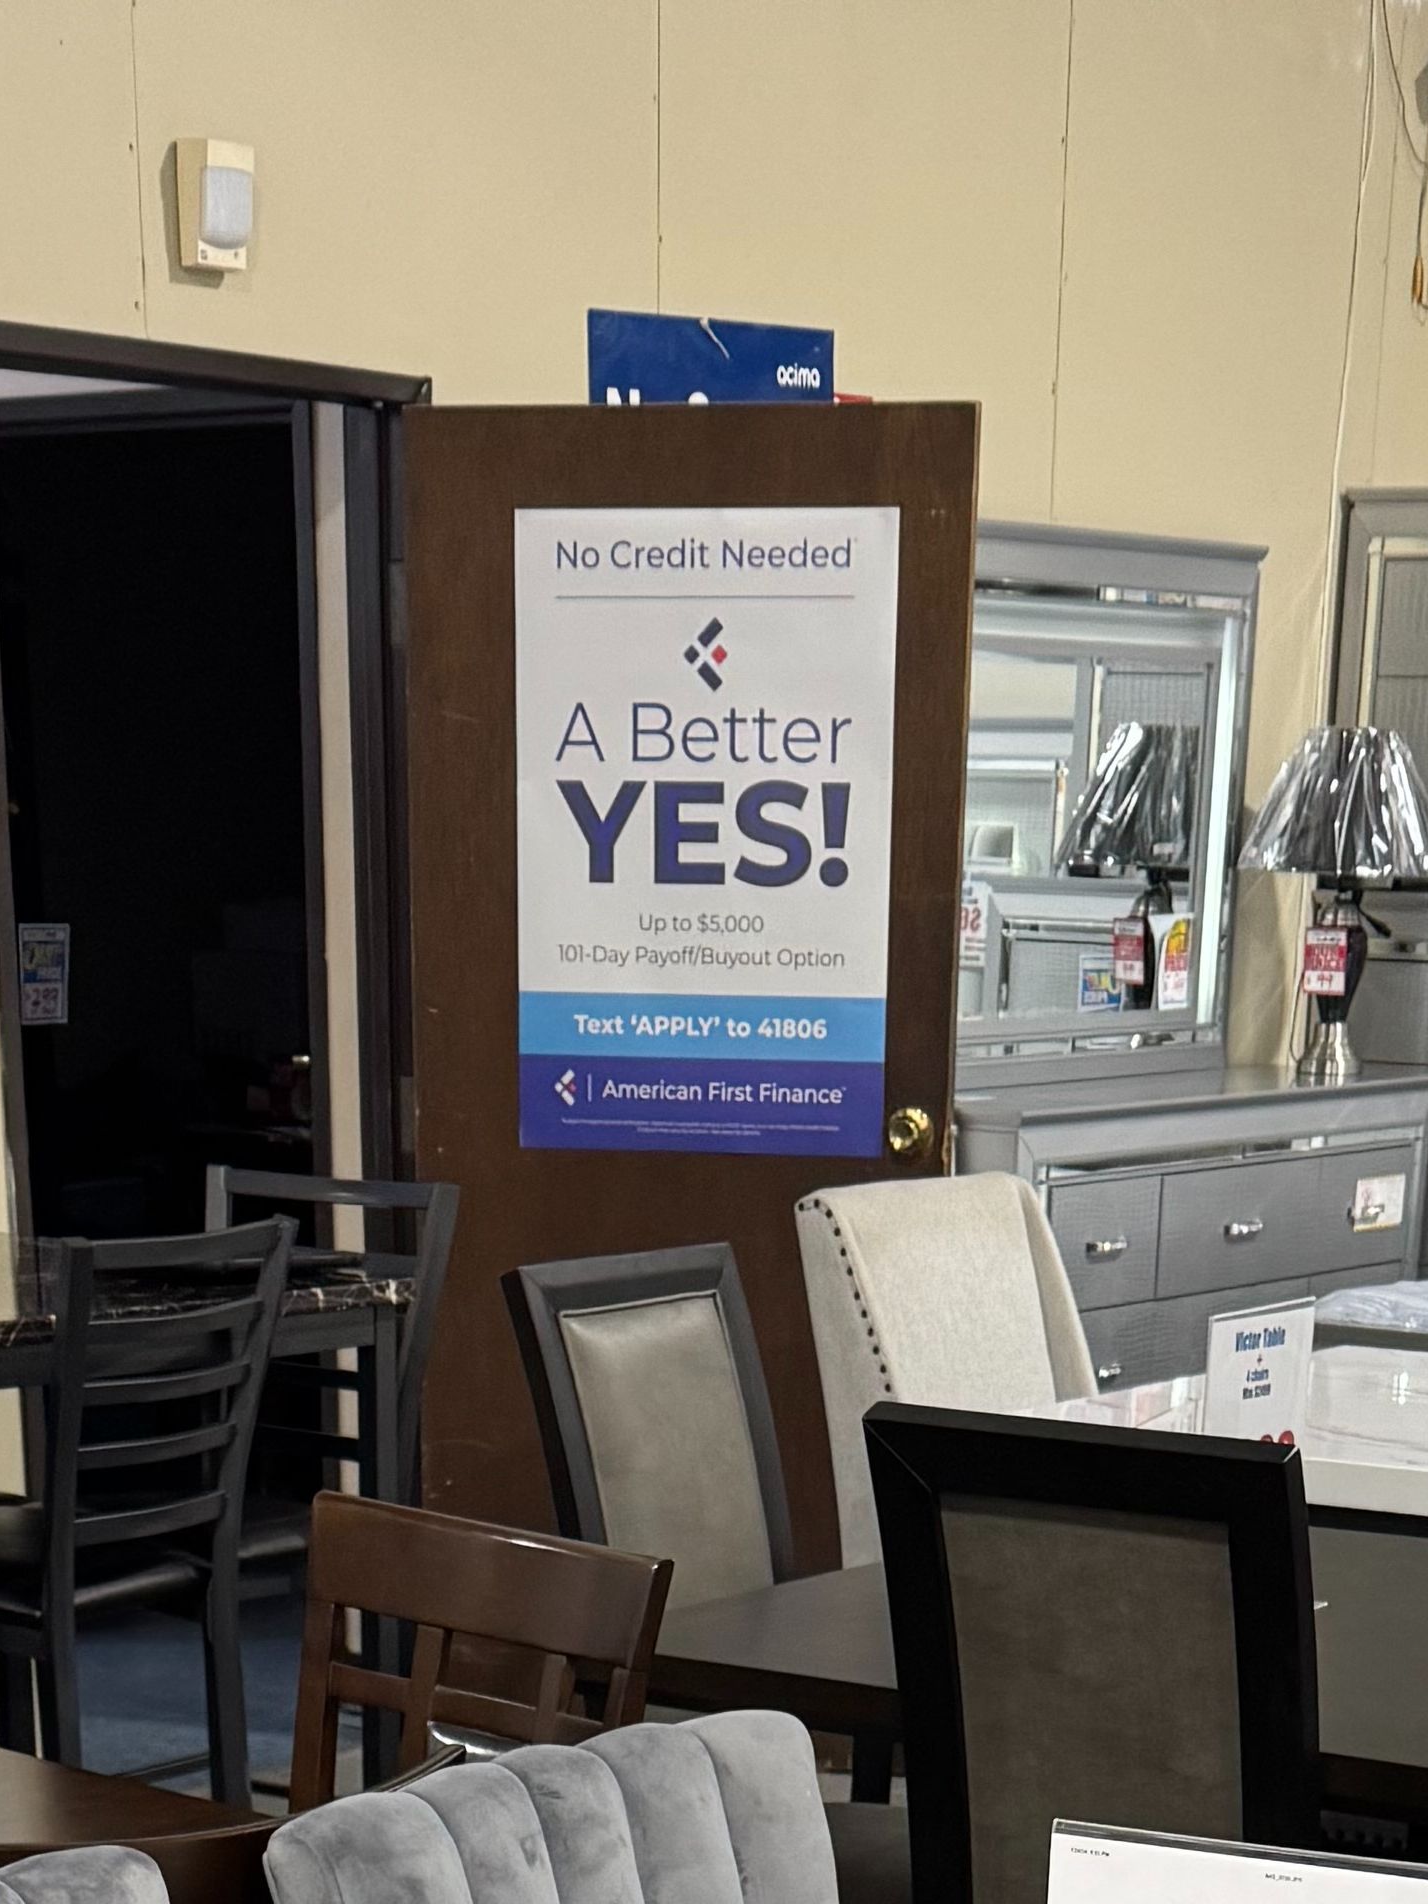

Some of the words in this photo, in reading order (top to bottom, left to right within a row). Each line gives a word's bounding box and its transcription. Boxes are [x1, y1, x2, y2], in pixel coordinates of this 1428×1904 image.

[777, 363, 821, 388] acima
[556, 540, 600, 569] No
[610, 538, 710, 569] Credit
[722, 538, 851, 569] Needed
[556, 702, 606, 763] A
[632, 702, 853, 764] Better
[556, 779, 851, 888] YES!
[638, 914, 667, 935] Up
[672, 916, 693, 933] to
[697, 914, 765, 935] $5,000
[558, 944, 630, 968] 101-Day
[635, 945, 772, 970] Payoff/Buyout
[777, 948, 845, 971] Option
[573, 1014, 623, 1036] Text
[726, 1017, 751, 1038] to
[757, 1017, 828, 1040] 41806
[602, 1079, 702, 1102] American
[708, 1081, 754, 1103] First
[761, 1083, 843, 1105] Finance
